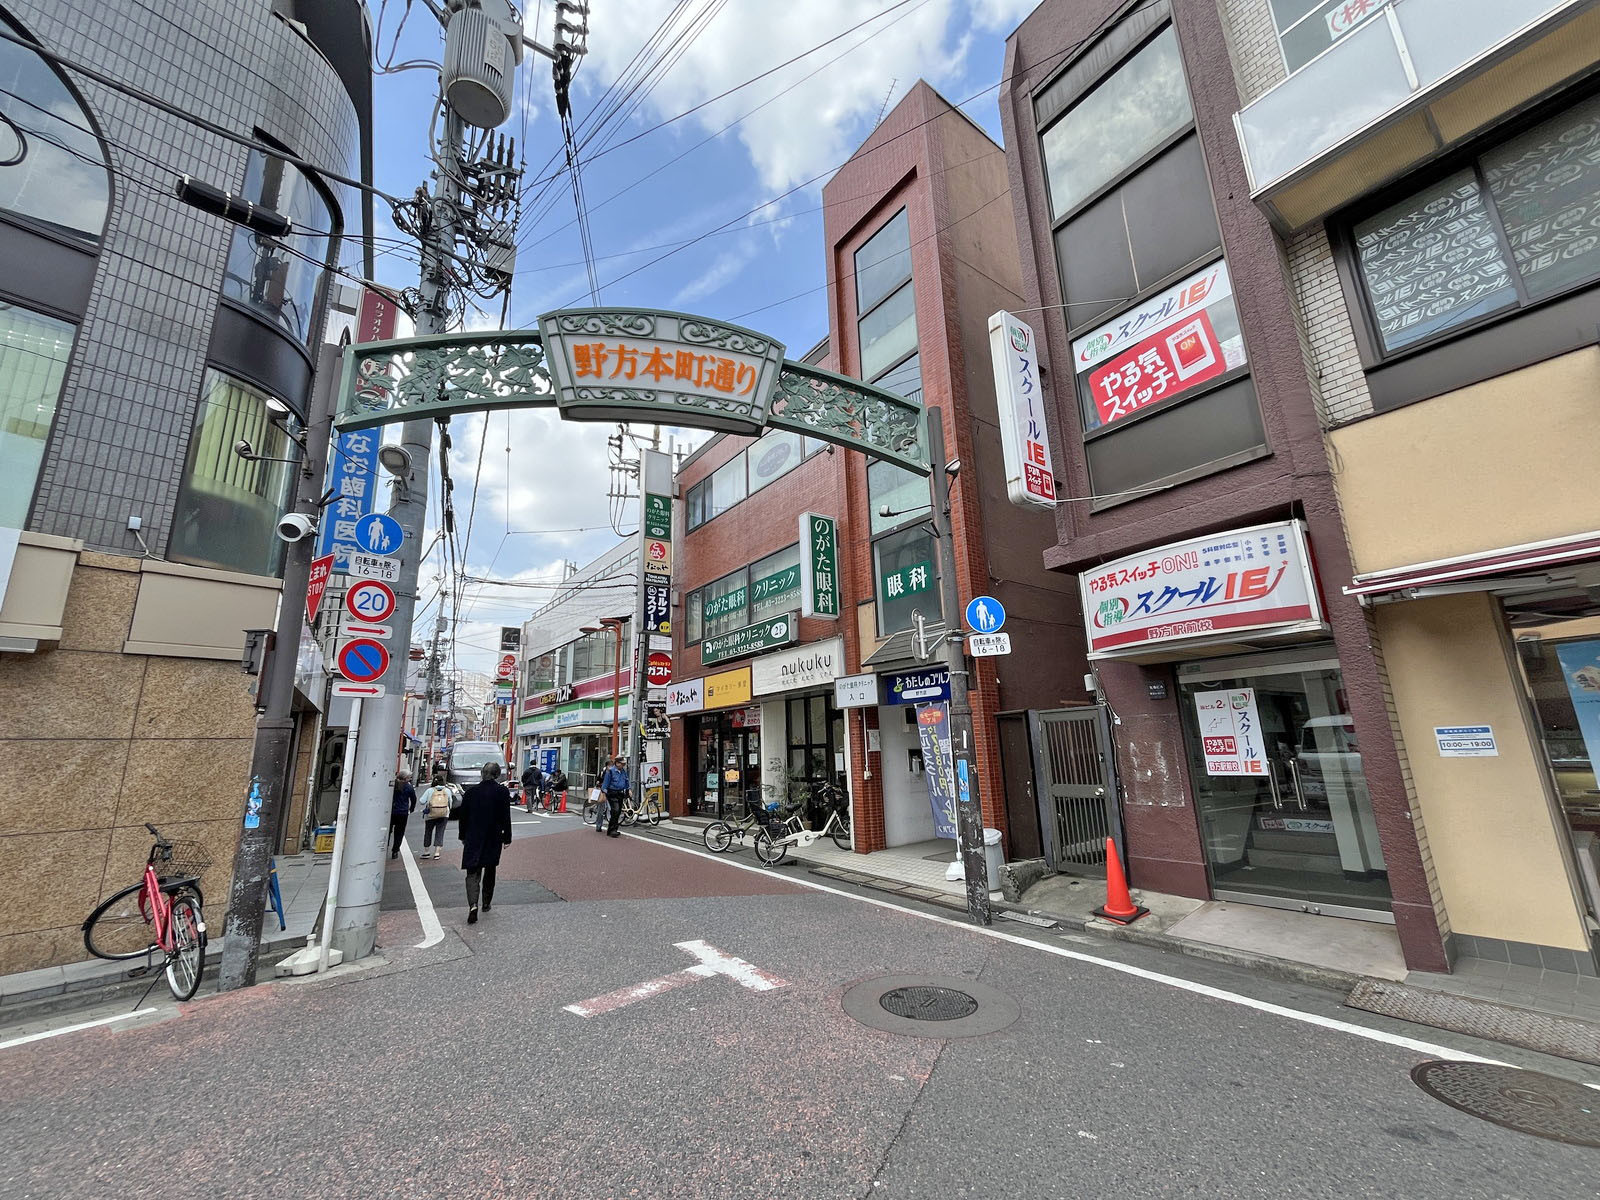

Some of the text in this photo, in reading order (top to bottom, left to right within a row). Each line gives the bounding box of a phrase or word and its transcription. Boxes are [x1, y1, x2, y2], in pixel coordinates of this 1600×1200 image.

[1180, 337, 1196, 351] ON
[573, 343, 758, 396] 野方本町通り
[1100, 346, 1165, 397] やる気
[1103, 367, 1174, 422] スイッチ
[1019, 355, 1046, 467] スクールIE
[332, 432, 372, 563] なお歯科医院
[355, 556, 397, 572] 自転車を除く
[815, 519, 834, 613] のがた眼科
[1089, 551, 1199, 595] やる気スイッチON!
[308, 583, 324, 597] STOP
[706, 571, 795, 616] のがた眼科 クリニック
[887, 565, 928, 598] 眼科
[357, 591, 386, 611] 20
[647, 596, 657, 631] スクール
[658, 588, 668, 616] ゴルフ
[1100, 598, 1119, 614] 個別
[1104, 609, 1123, 626] 指導
[1148, 619, 1214, 639] 野方駅前校
[713, 624, 785, 651] のがた眼科クリニック 2F
[647, 666, 672, 676] ガスト
[781, 653, 831, 676] nukuku
[905, 672, 950, 688] わたしのゴルフ
[849, 691, 865, 701] 入口
[1205, 739, 1224, 747] やる気
[1206, 745, 1226, 753] スイッチ
[1237, 711, 1263, 773] スクールIE
